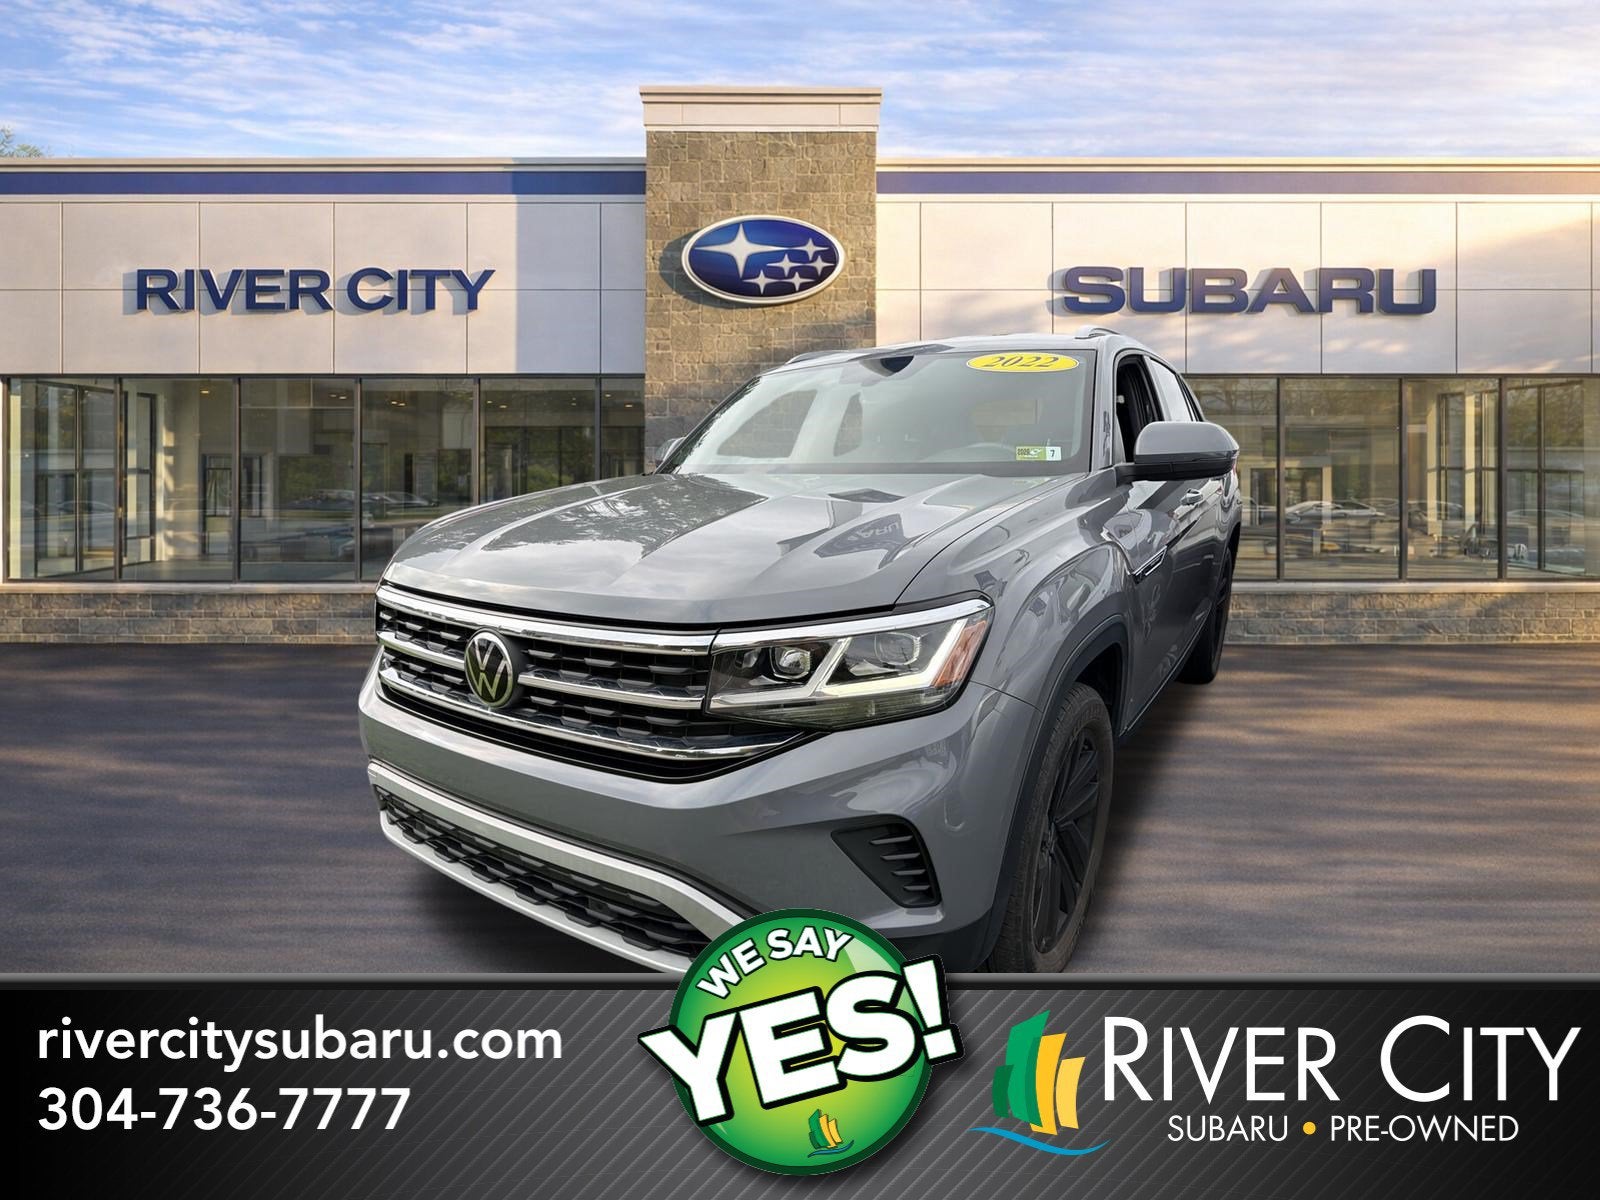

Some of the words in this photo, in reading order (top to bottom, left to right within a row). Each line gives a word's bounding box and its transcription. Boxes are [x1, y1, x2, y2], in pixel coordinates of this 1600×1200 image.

[136, 269, 334, 311] RIVER
[347, 267, 496, 311] CITY
[1063, 266, 1437, 315] SUBARU
[983, 356, 1059, 368] 2022
